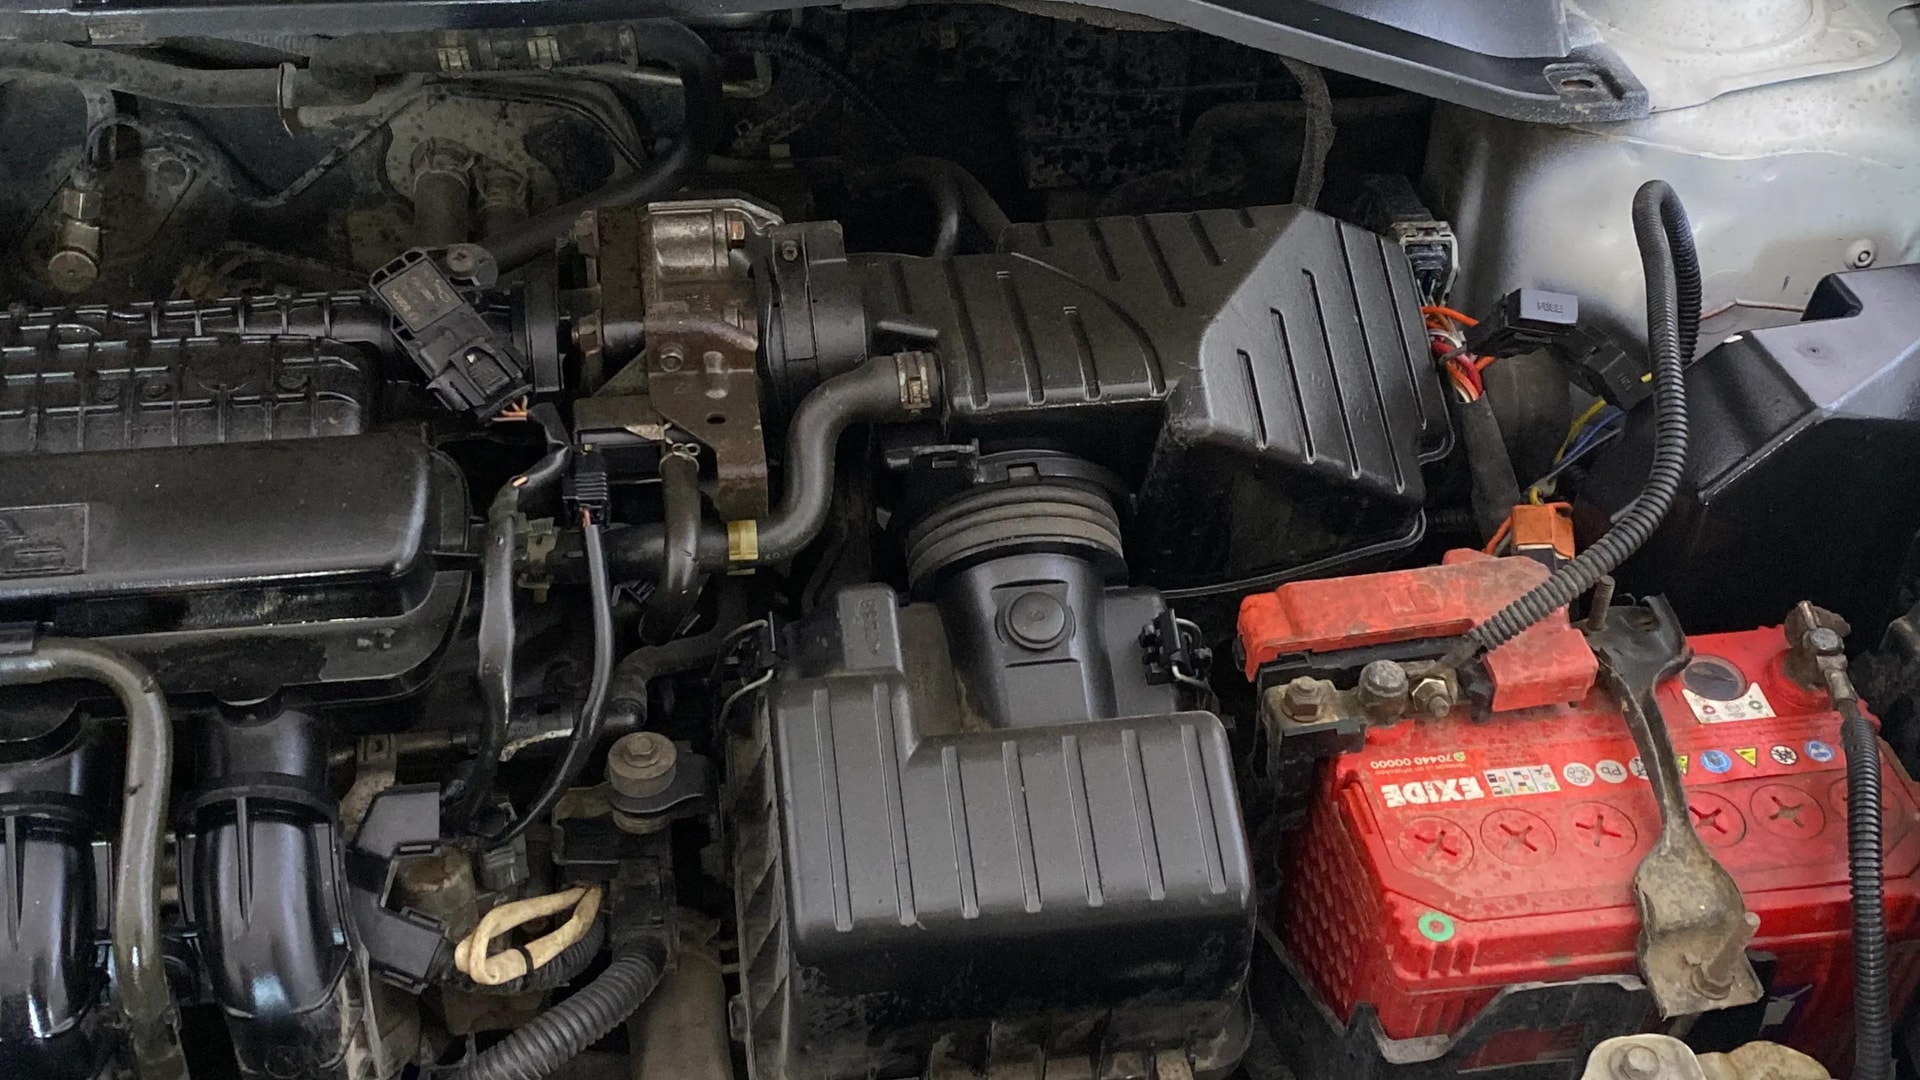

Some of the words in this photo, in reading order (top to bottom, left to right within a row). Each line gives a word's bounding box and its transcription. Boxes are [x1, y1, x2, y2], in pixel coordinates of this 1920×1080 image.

[1370, 758, 1411, 769] 00000
[1414, 754, 1453, 765] 70440
[1600, 765, 1622, 777] Pb
[1381, 776, 1484, 808] EXIDE
